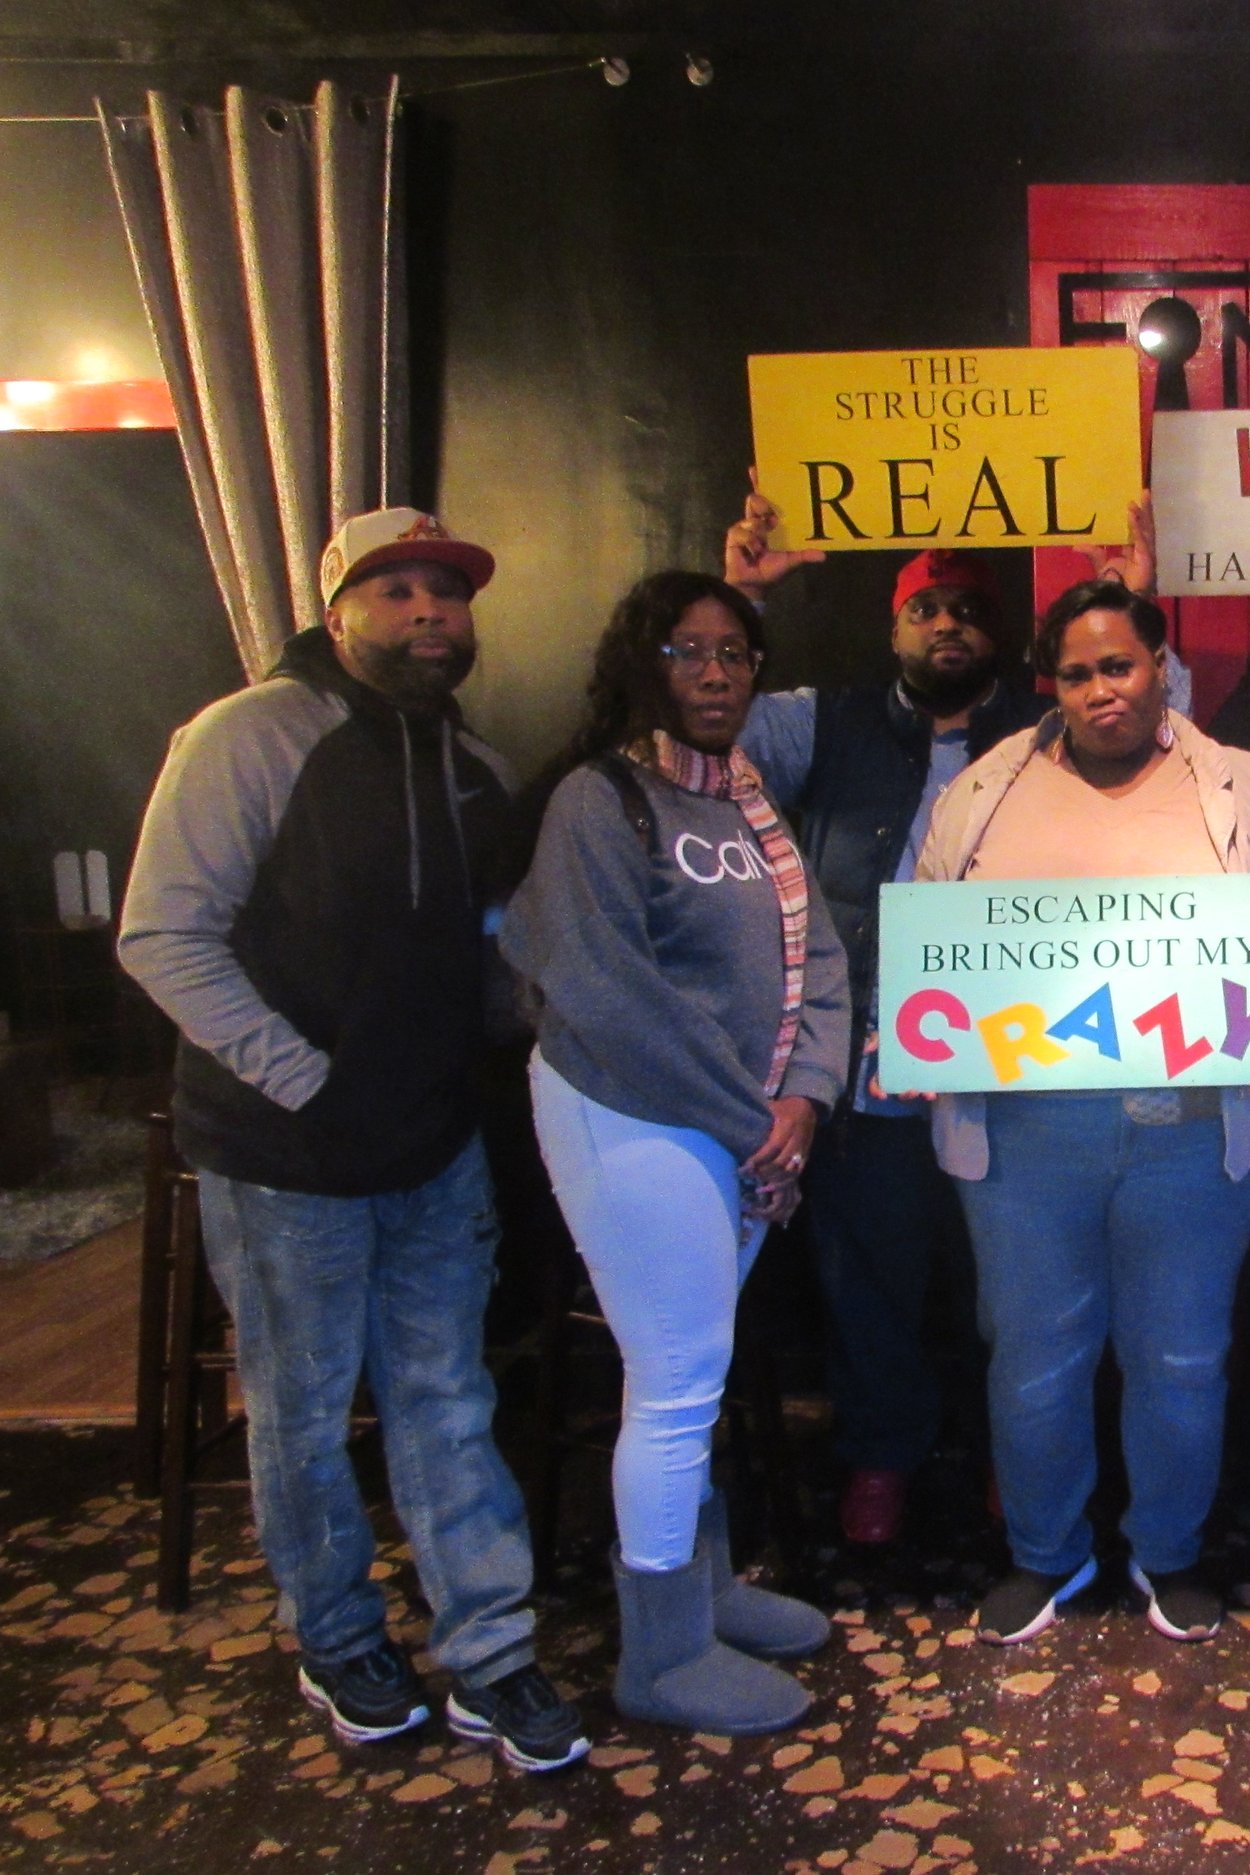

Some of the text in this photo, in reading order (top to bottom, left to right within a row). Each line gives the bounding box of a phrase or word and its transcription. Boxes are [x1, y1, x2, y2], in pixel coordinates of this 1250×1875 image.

[901, 356, 979, 385] THE
[835, 388, 1050, 420] STRUGGLE
[929, 422, 962, 451] IS
[800, 455, 1098, 541] REAL
[985, 891, 1197, 925] ESCAPING
[921, 940, 1080, 973] BRINGS
[1093, 938, 1181, 968] OUT
